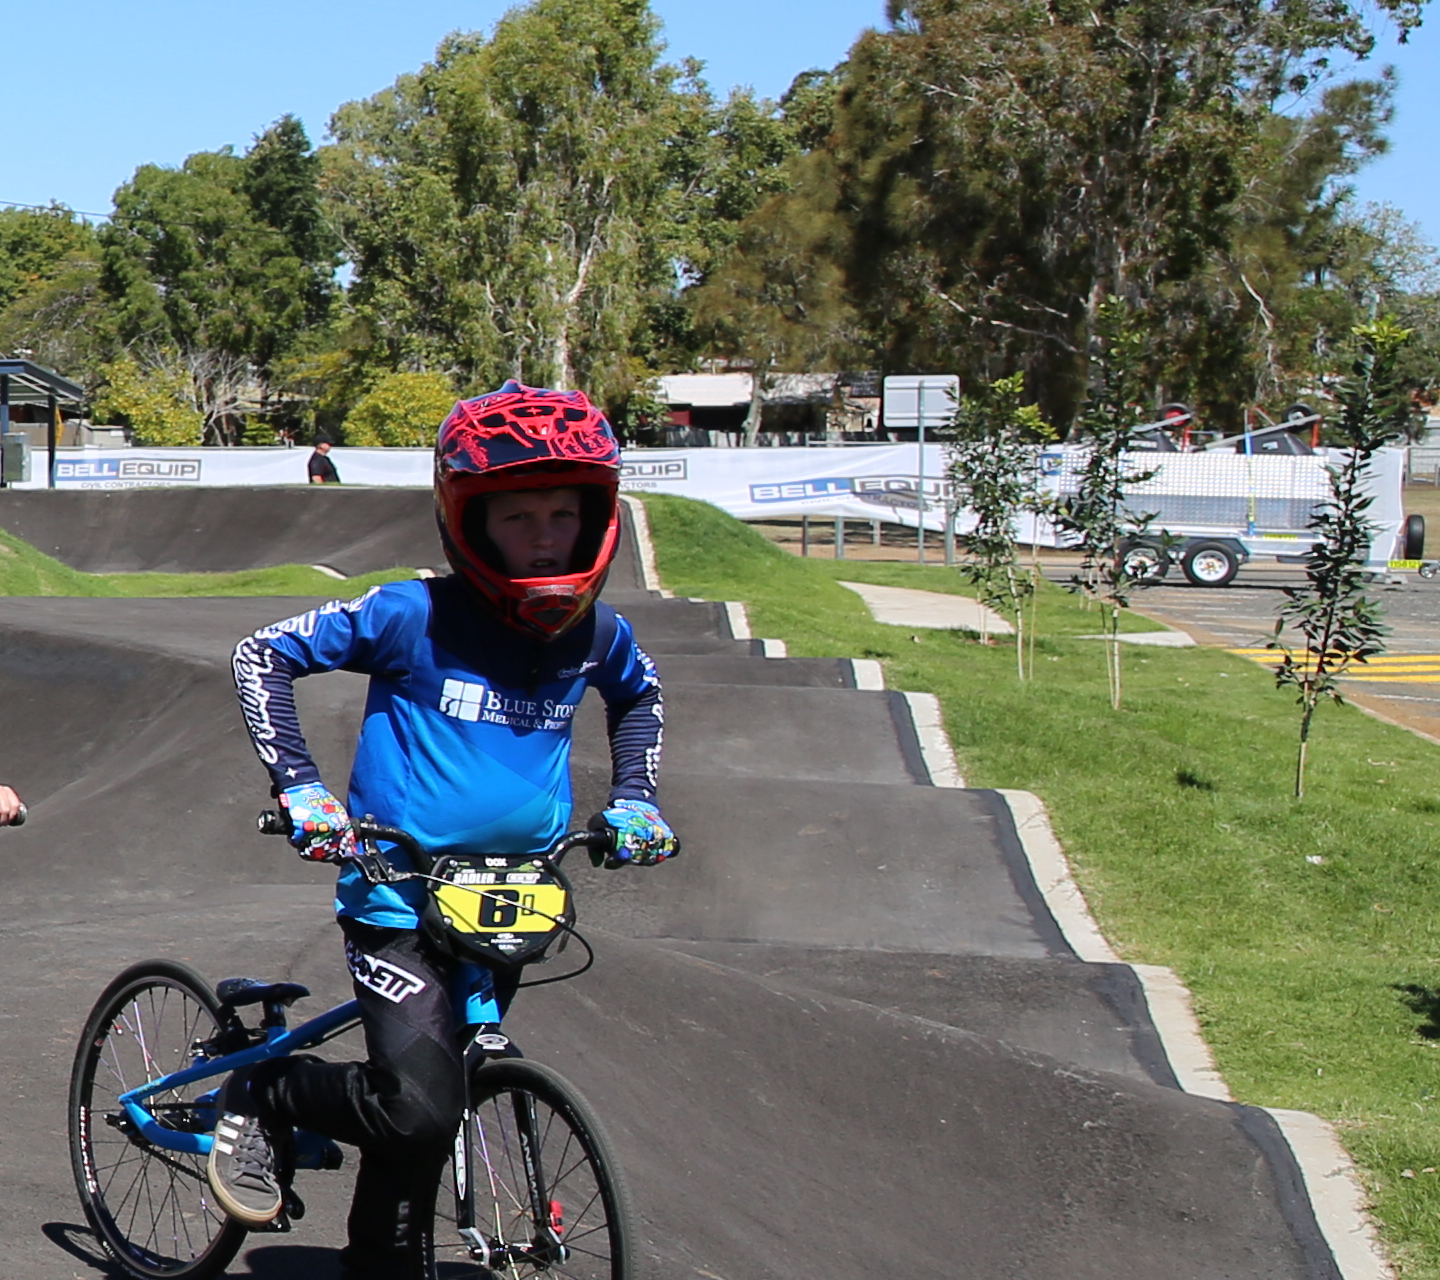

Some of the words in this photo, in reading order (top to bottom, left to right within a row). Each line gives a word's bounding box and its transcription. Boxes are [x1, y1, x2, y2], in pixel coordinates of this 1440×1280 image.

[57, 462, 117, 477] BELL
[122, 462, 196, 476] EQUIP
[621, 464, 682, 476] QUIP
[753, 481, 845, 500] BELL
[485, 690, 536, 716] BLUE
[453, 872, 496, 884] SADLER
[478, 889, 519, 928] 6
